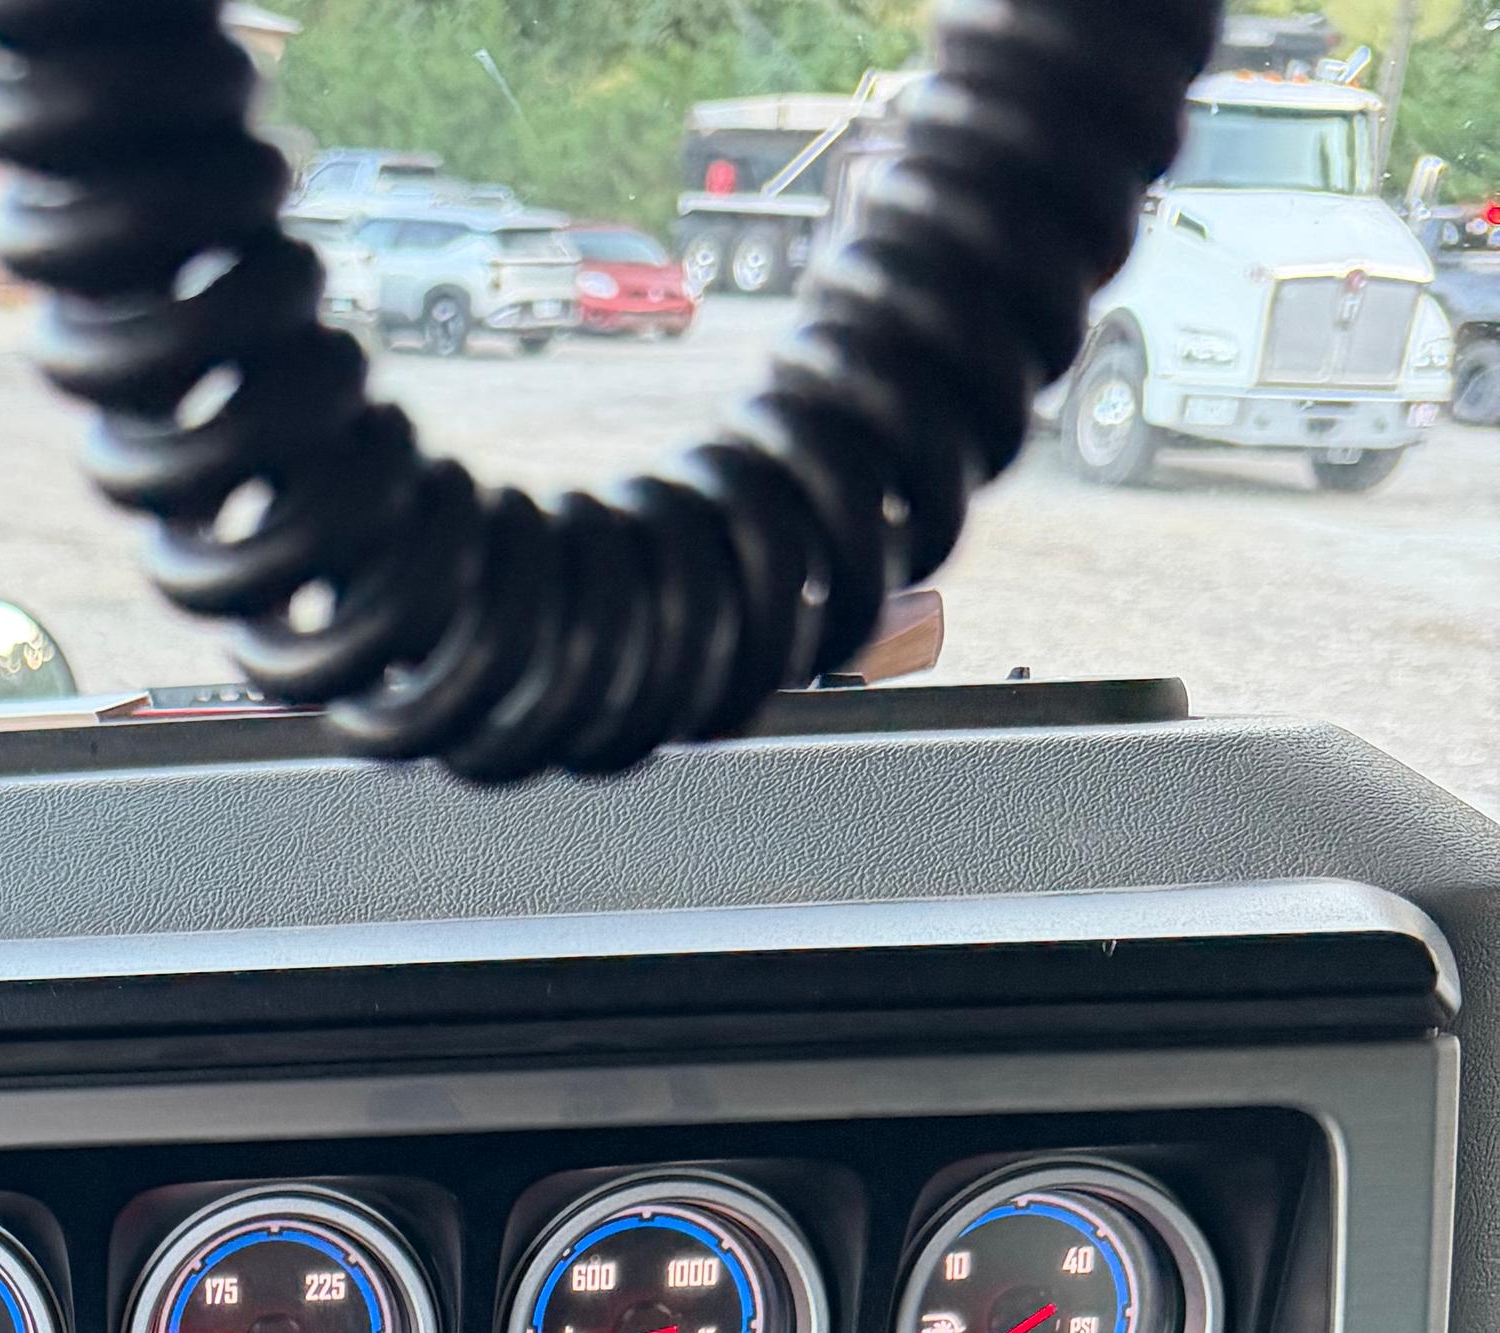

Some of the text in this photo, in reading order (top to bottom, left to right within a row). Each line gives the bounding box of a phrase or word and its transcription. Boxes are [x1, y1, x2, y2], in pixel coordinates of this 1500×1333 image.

[667, 1258, 719, 1287] 1000
[944, 1252, 971, 1280] 10
[1062, 1246, 1095, 1274] 40
[205, 1277, 238, 1304] 175
[305, 1273, 346, 1301] 225
[572, 1263, 616, 1291] 600
